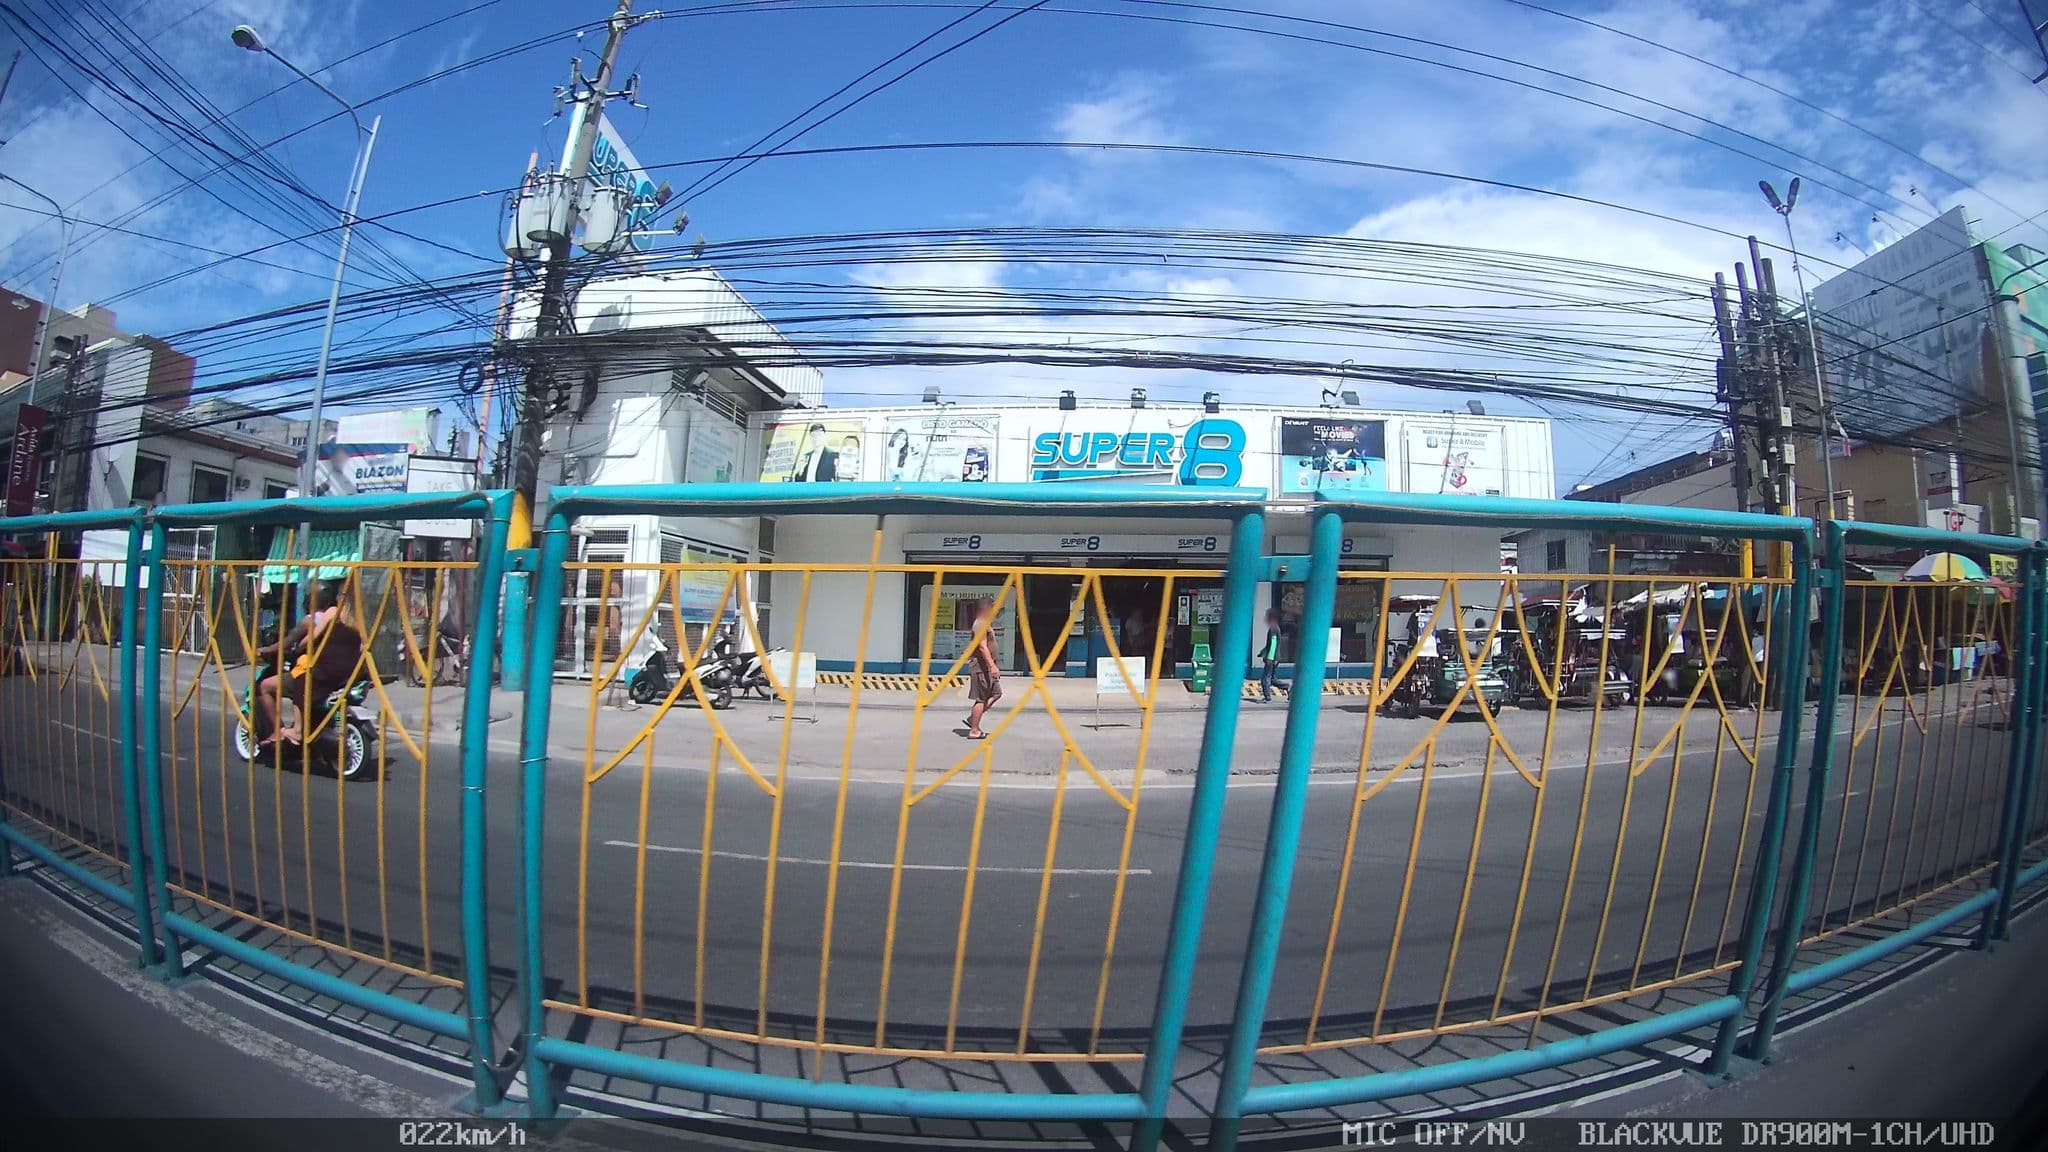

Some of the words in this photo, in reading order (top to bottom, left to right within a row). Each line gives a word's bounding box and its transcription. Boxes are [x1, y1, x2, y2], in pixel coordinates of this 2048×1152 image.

[1032, 432, 1176, 466] SUPER
[1178, 418, 1248, 487] 8
[943, 537, 968, 546] SUPER
[968, 535, 981, 549] 8
[1061, 537, 1086, 546] SUPER
[1087, 536, 1100, 550] 8
[1178, 538, 1203, 547] SUPER
[1204, 536, 1217, 551] 8
[1341, 539, 1354, 552] 8
